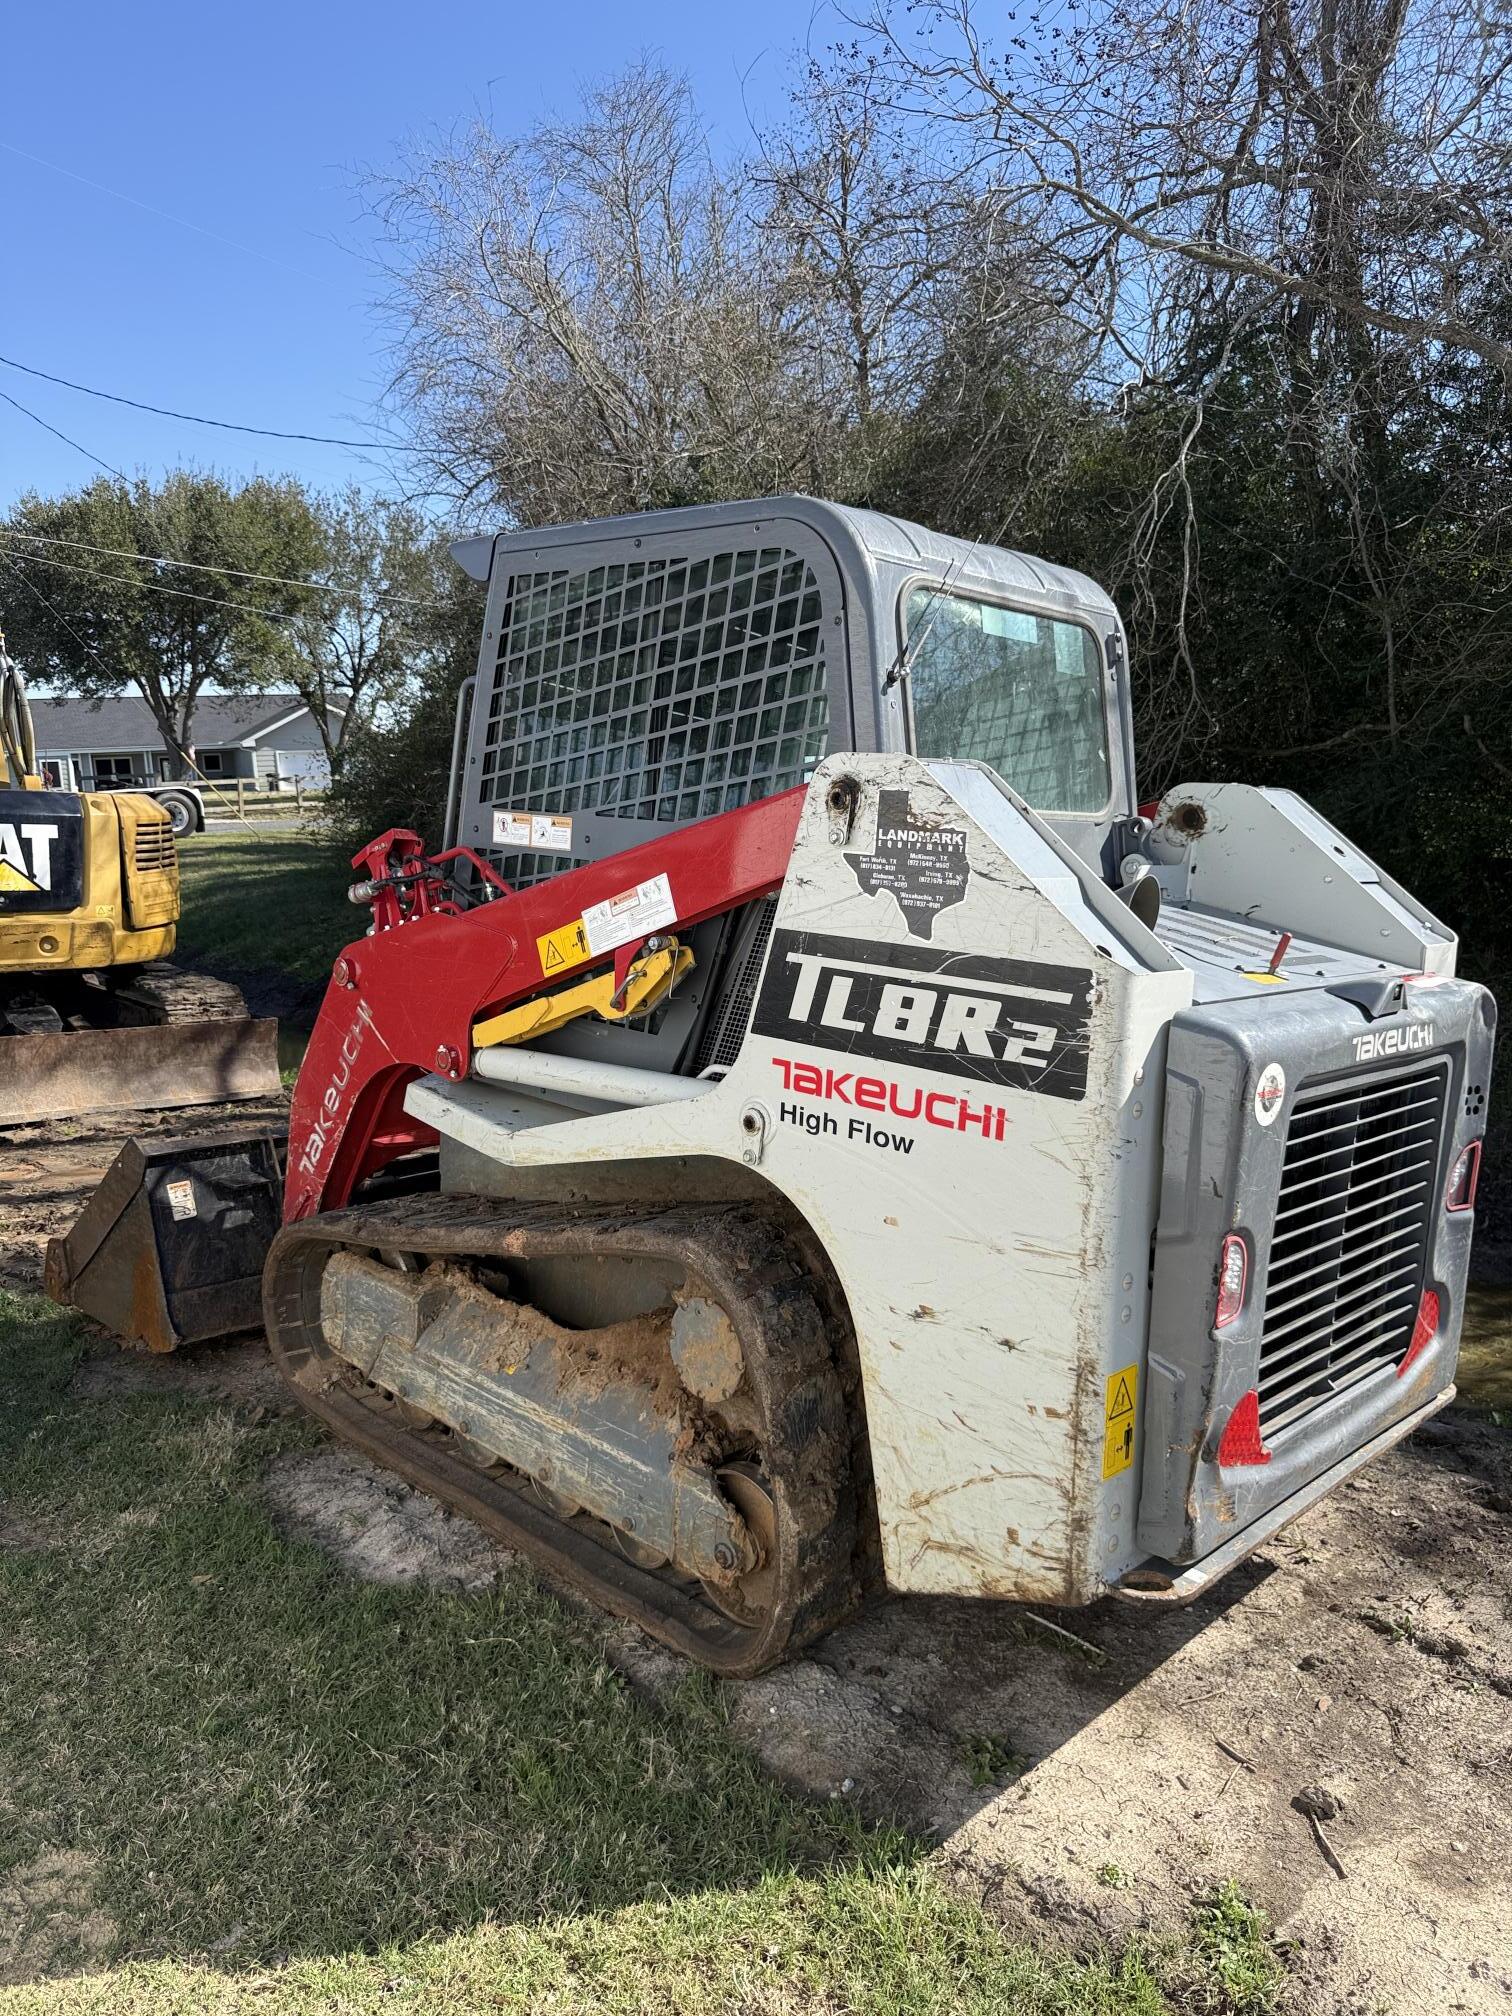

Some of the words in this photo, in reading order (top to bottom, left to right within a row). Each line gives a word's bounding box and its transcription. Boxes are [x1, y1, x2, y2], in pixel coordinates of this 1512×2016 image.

[878, 828, 964, 845] LANDMARK
[877, 839, 964, 853] EQUIPMENT
[939, 854, 948, 862] TX
[944, 871, 953, 879] TX
[935, 895, 944, 903] TX
[785, 951, 1074, 1069] TL8R2
[779, 1101, 838, 1137] High
[848, 1117, 915, 1155] Flow
